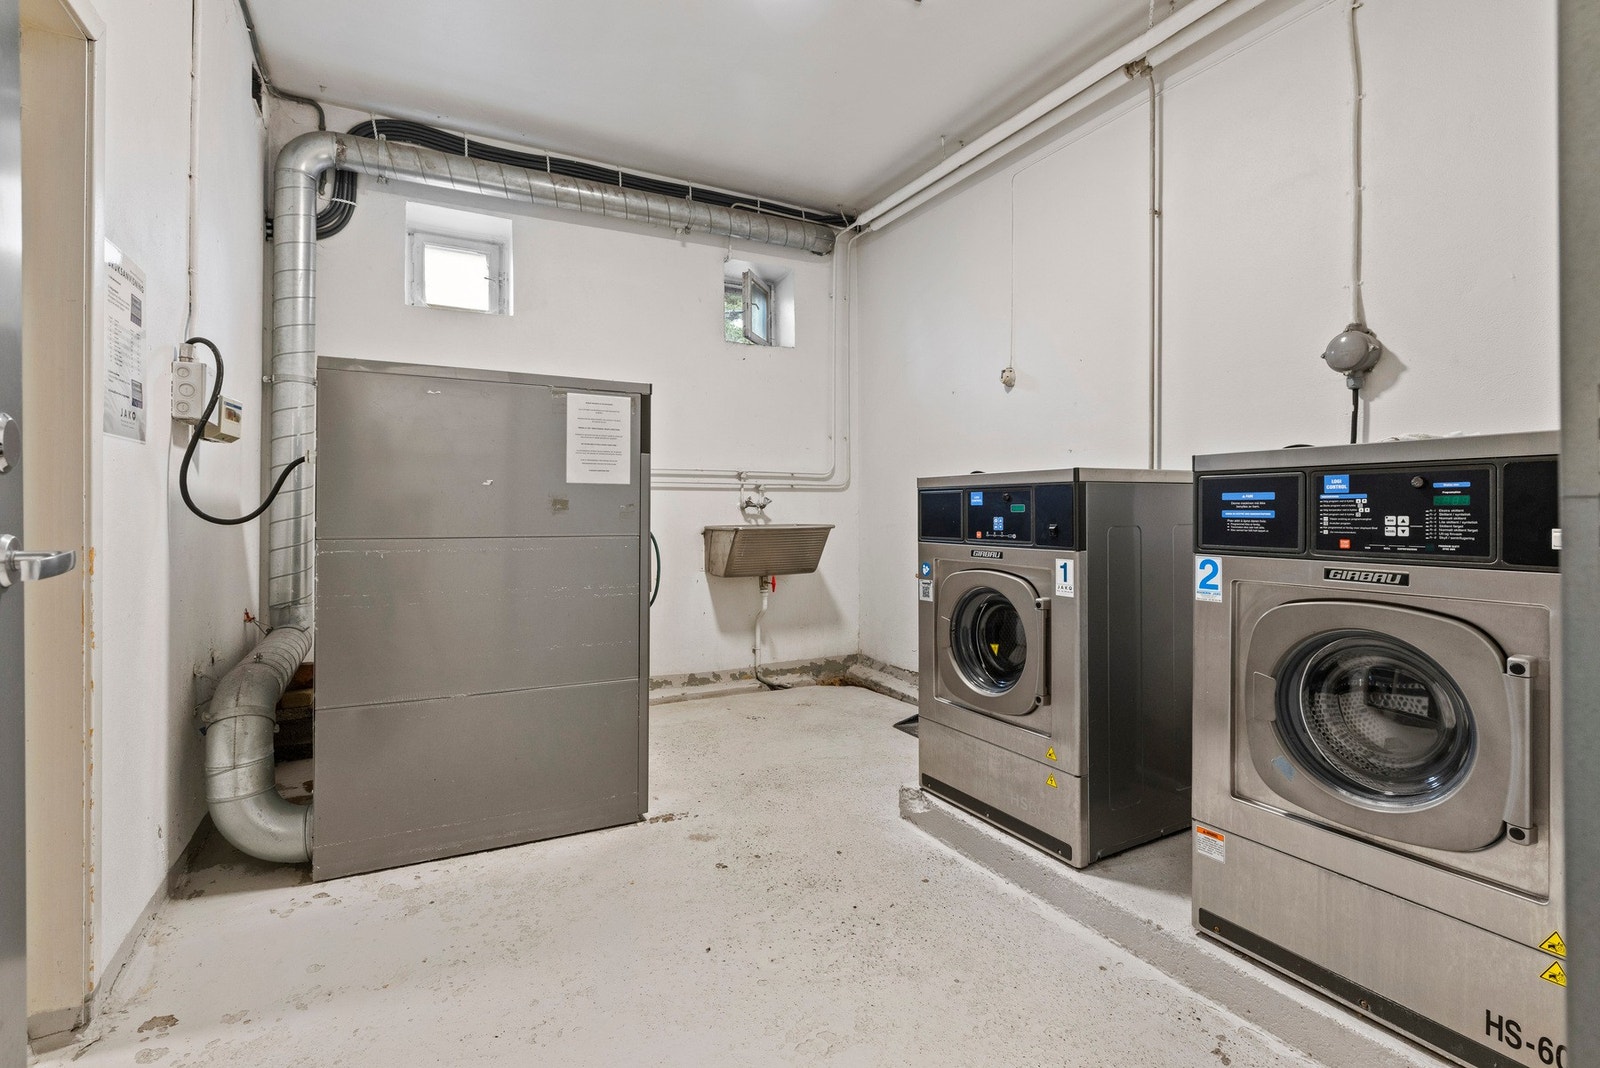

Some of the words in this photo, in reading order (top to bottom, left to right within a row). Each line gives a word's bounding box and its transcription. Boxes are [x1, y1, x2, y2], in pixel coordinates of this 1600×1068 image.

[1060, 562, 1067, 582] 1
[1199, 559, 1219, 590] 2
[1328, 569, 1402, 584] GIRBAU
